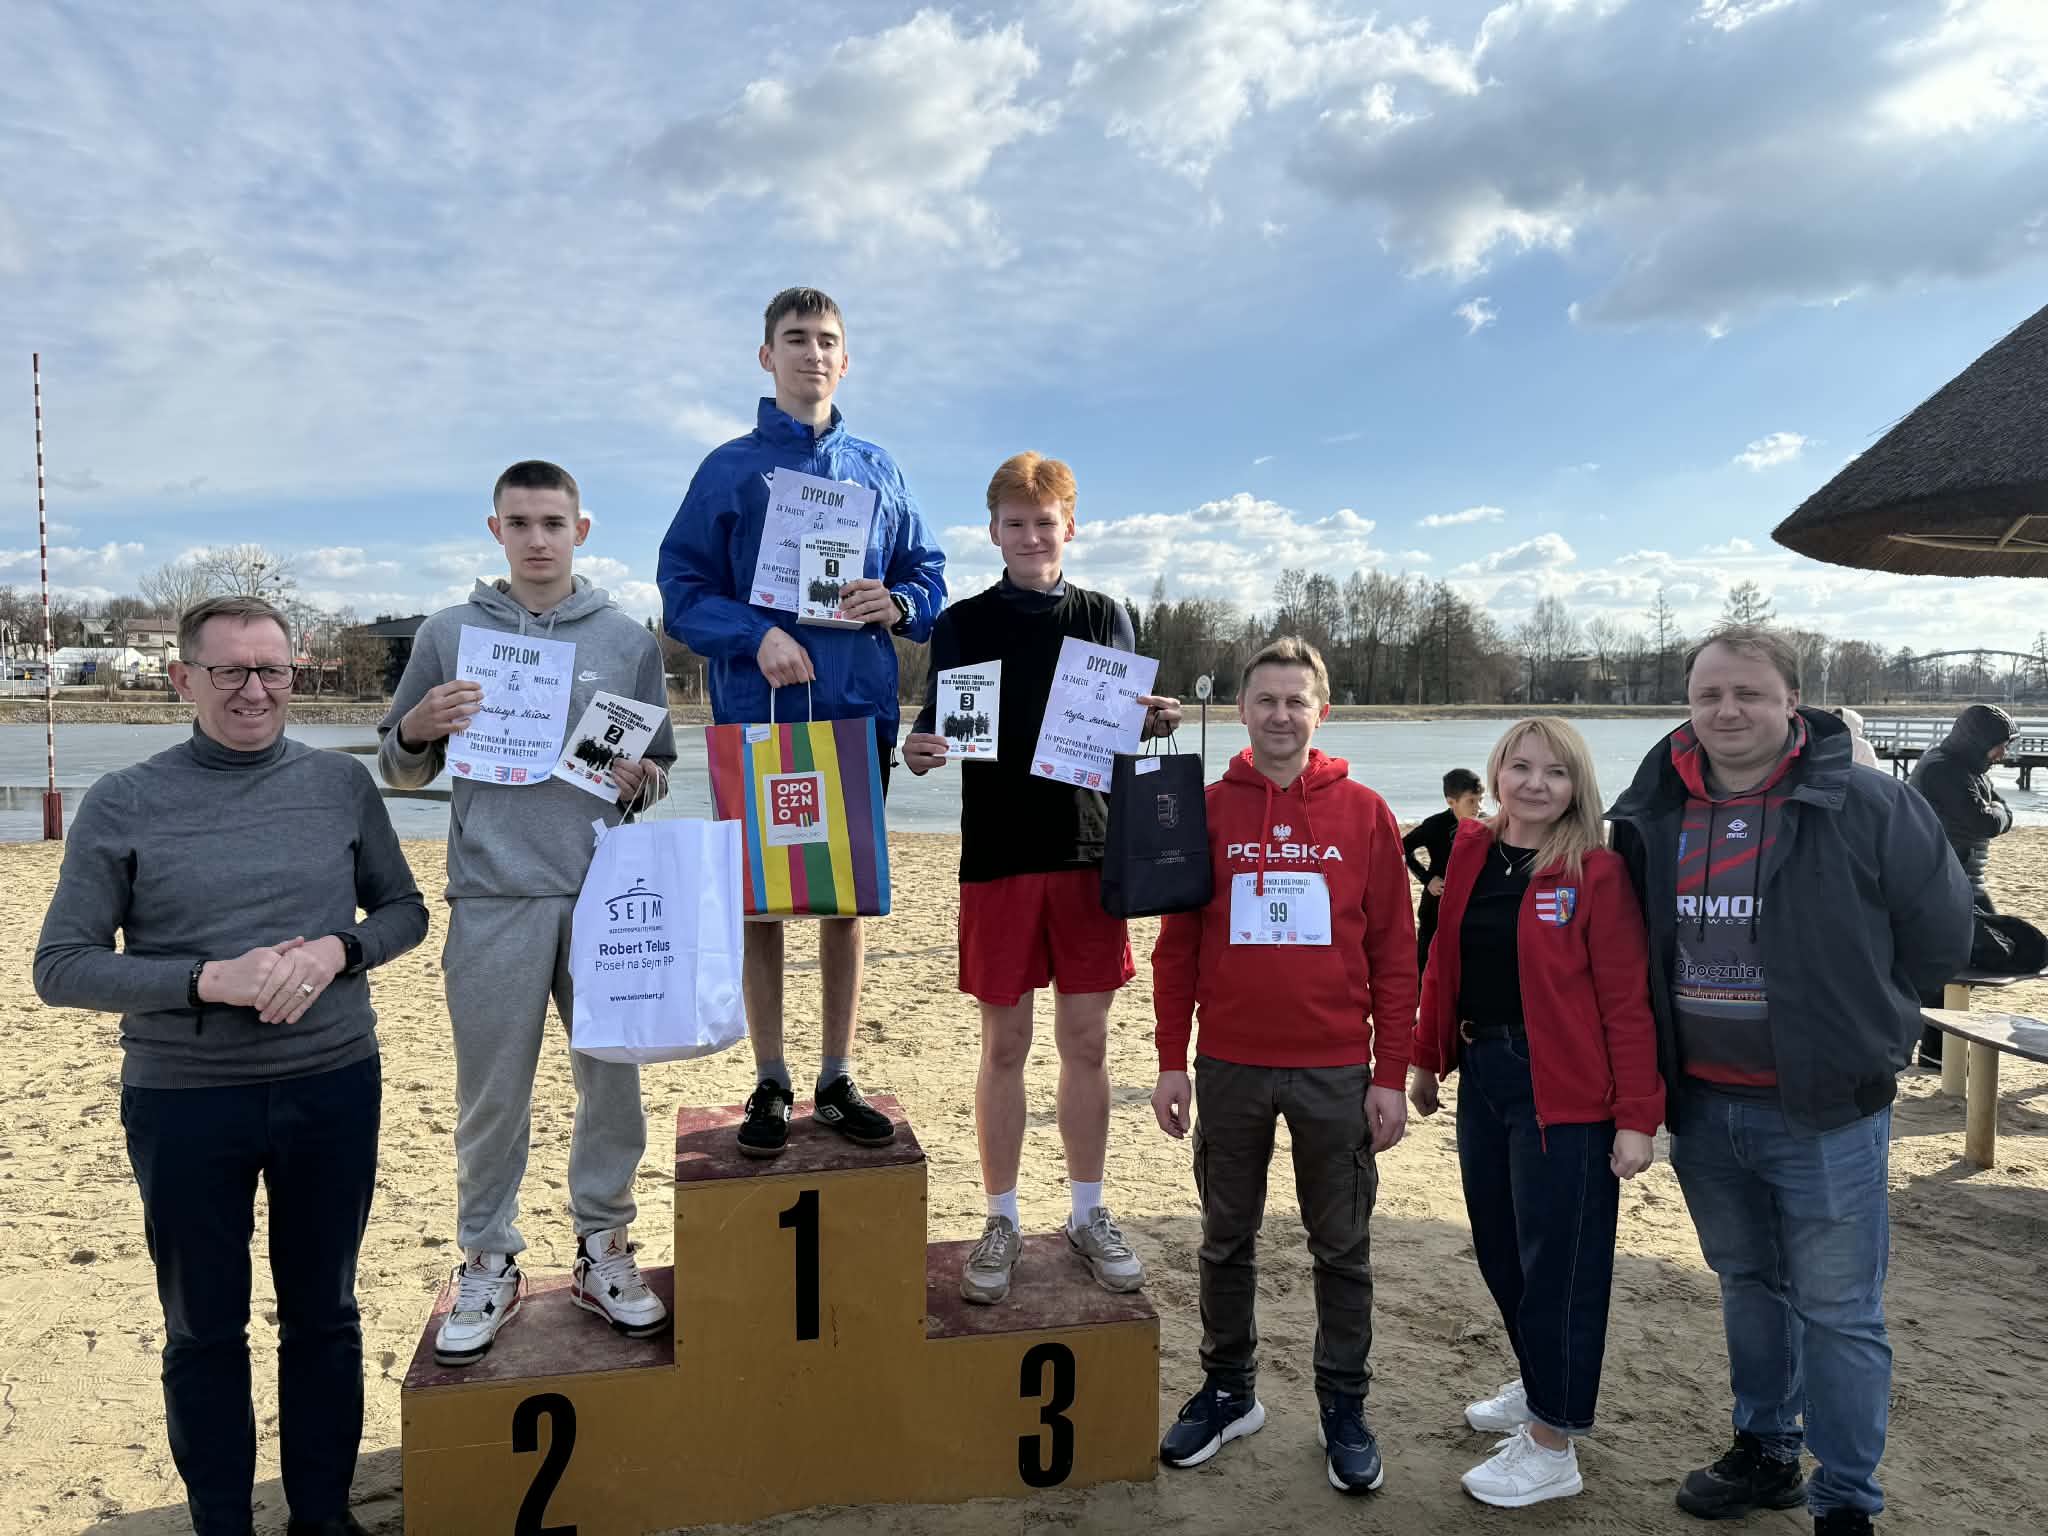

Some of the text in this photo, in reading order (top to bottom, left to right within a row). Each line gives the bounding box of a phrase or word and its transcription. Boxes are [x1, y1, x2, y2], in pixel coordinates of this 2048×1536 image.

[801, 485, 845, 509] DYPLOM
[813, 521, 824, 530] DLA
[828, 561, 835, 573] 1
[492, 643, 541, 666] DYPLOM
[1087, 655, 1128, 679] DYPLOM
[508, 683, 519, 691] DLA
[963, 694, 971, 706] 3
[1095, 693, 1105, 701] DLA
[609, 727, 620, 740] 2
[777, 782, 811, 795] OPO
[778, 794, 812, 808] CZN
[779, 809, 791, 820] O
[609, 900, 662, 924] SEJM
[1269, 902, 1288, 922] 99
[599, 939, 670, 956] Robert Telus
[595, 956, 674, 972] Poseł na Sejm RP
[778, 1189, 820, 1342] 1
[1018, 1342, 1076, 1488] 3
[511, 1392, 578, 1536] 2
